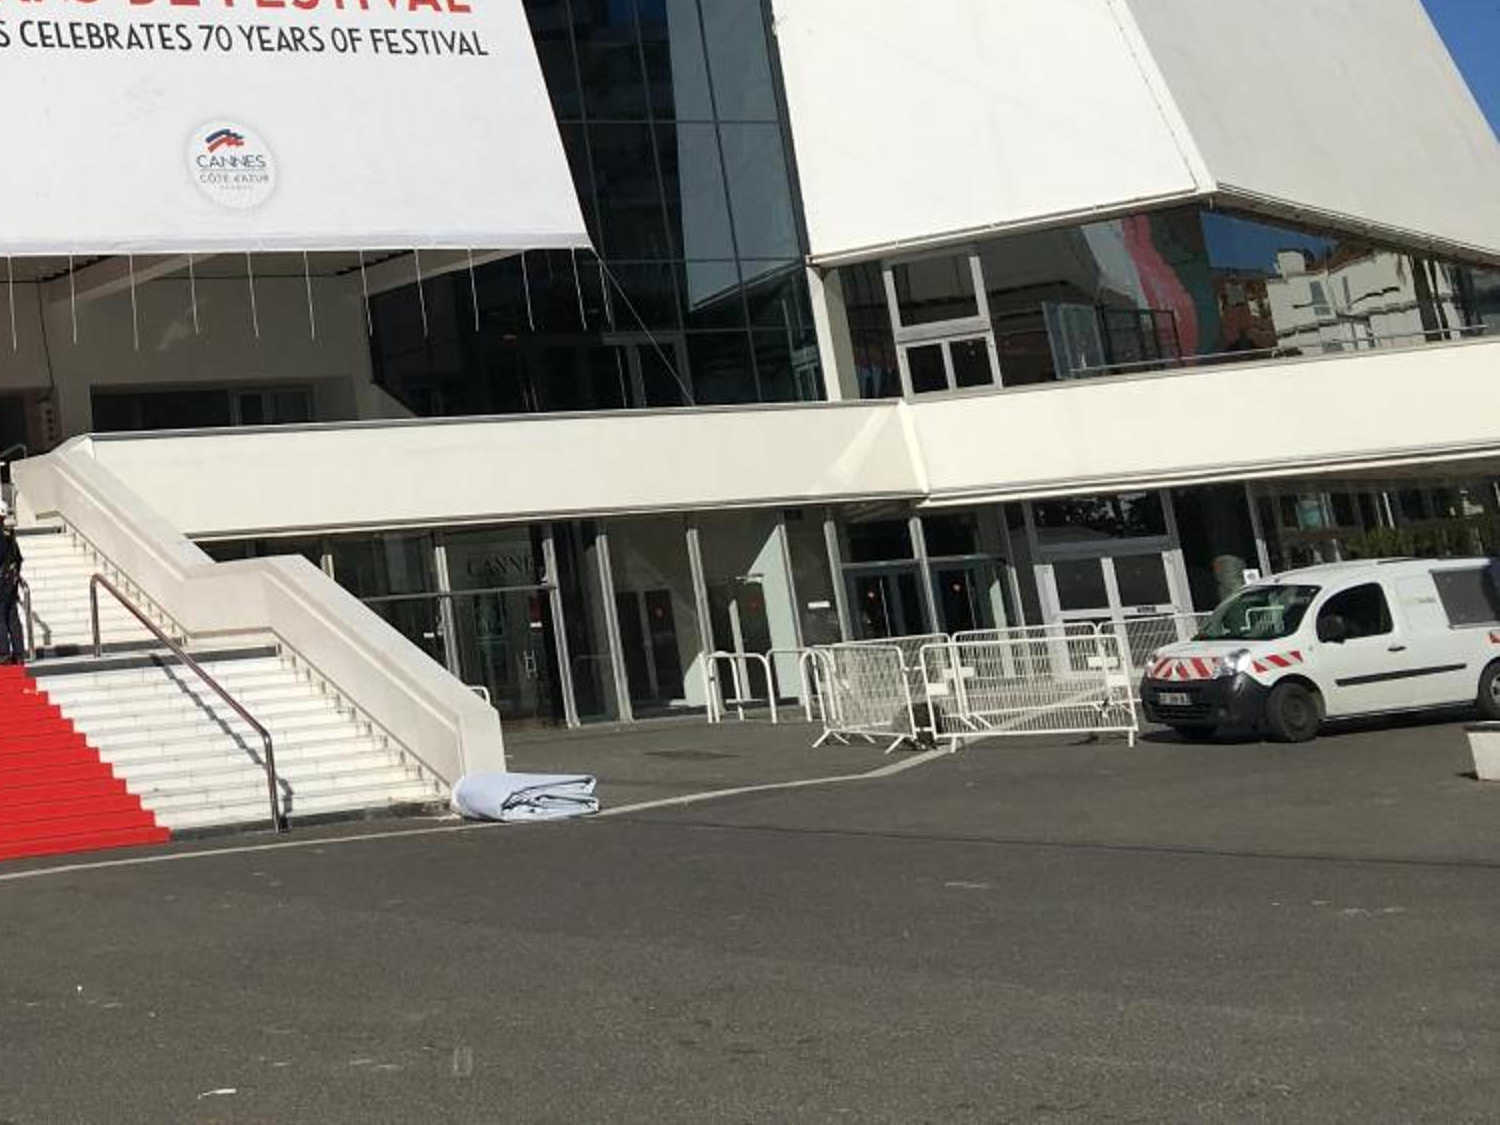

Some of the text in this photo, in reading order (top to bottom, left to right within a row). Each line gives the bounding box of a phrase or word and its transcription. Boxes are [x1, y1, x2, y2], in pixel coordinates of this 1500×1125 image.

[18, 19, 193, 52] CELEBRATES
[197, 24, 233, 53] 70
[237, 24, 326, 53] YEARS
[330, 26, 363, 54] OF
[369, 28, 490, 56] FESTIVAL
[196, 154, 267, 172] CANNES
